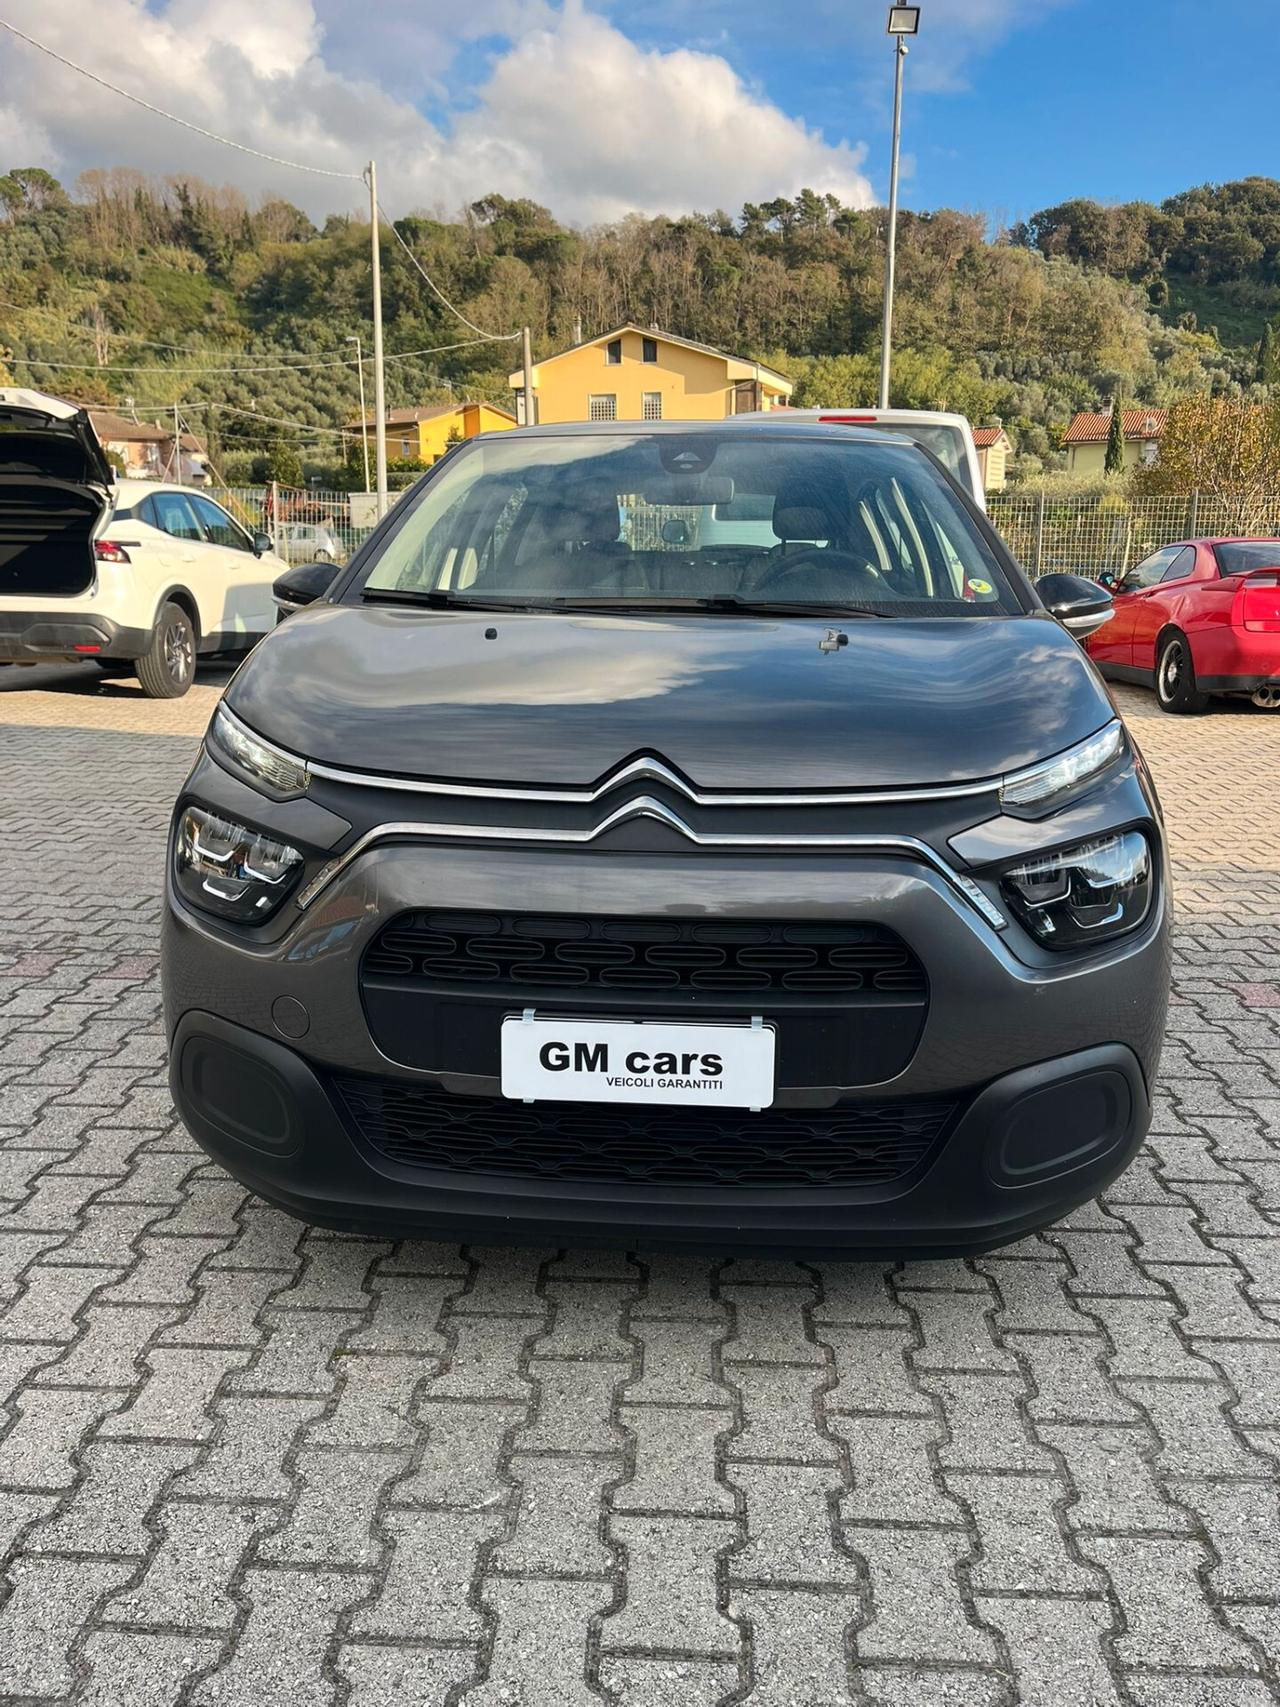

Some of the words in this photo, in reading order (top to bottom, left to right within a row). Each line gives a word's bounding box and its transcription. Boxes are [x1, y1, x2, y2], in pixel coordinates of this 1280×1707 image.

[539, 1041, 609, 1073] GM
[625, 1051, 724, 1077] cars
[606, 1076, 654, 1088] VEICOLI
[657, 1078, 723, 1090] GARANTITI
